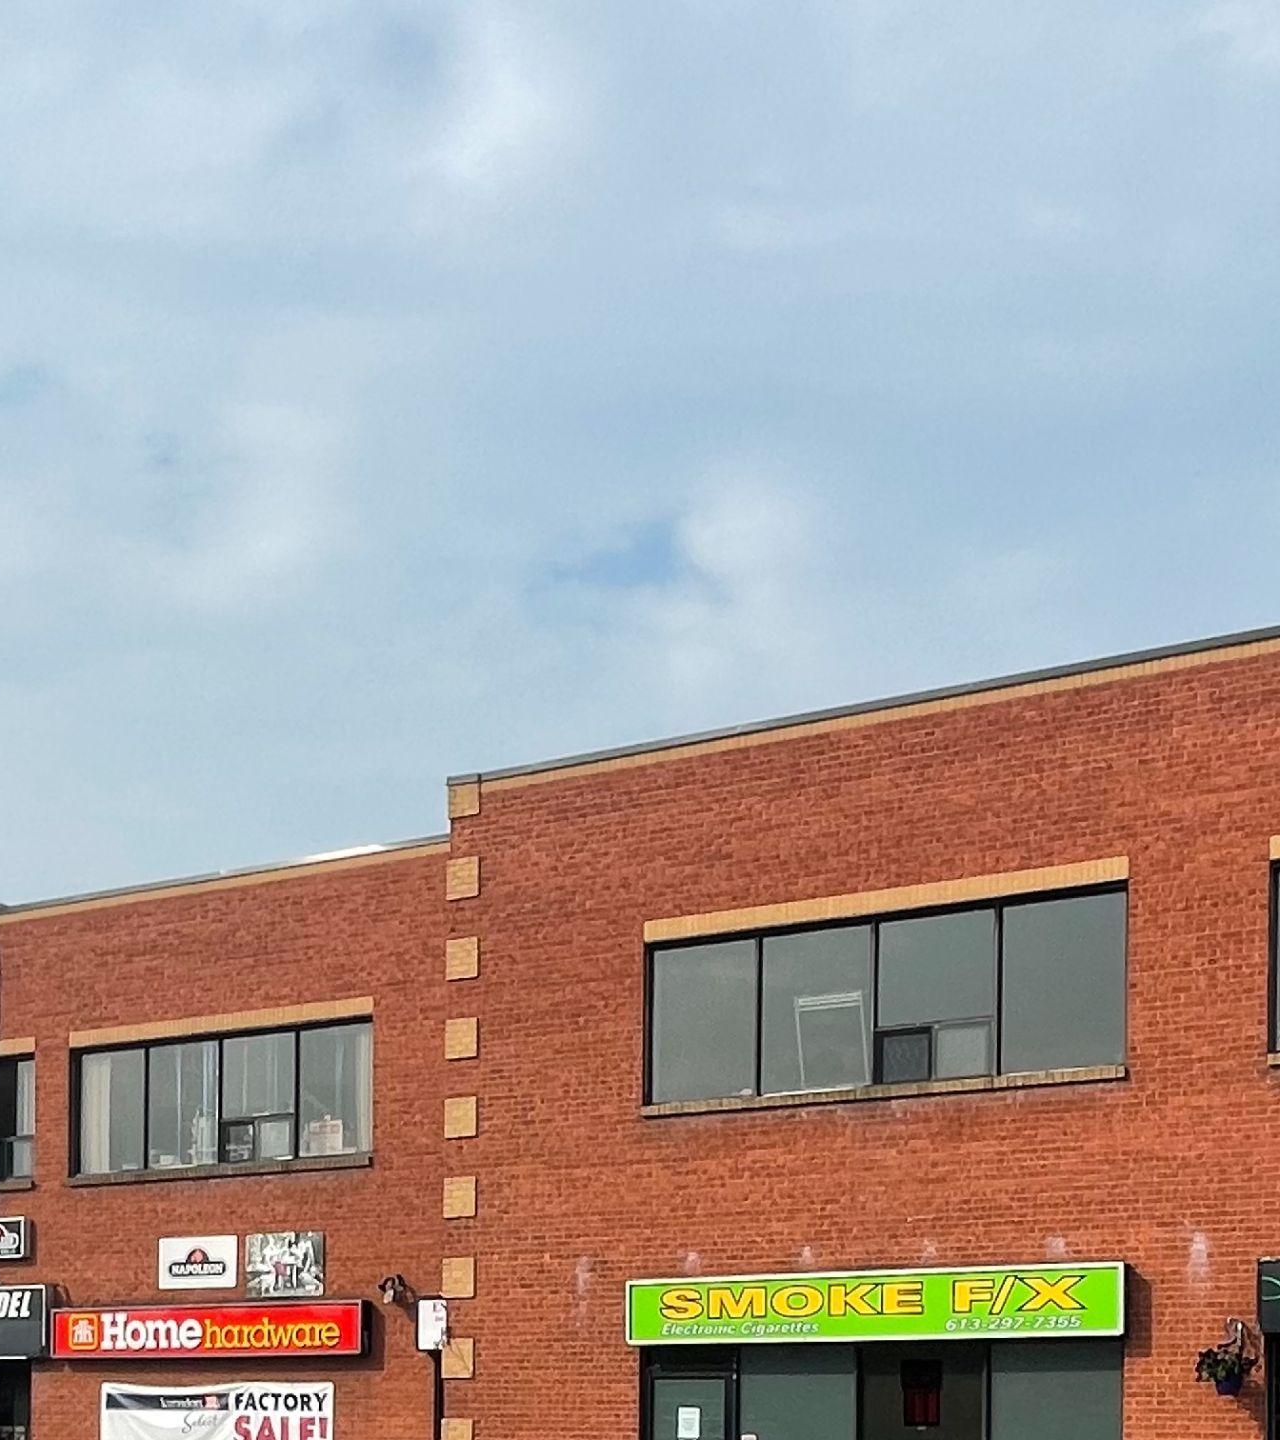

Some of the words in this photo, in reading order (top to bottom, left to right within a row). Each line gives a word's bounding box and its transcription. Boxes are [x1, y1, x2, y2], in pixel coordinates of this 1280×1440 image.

[659, 1281, 924, 1320] SMOKE
[952, 1275, 1087, 1315] F/X
[100, 1312, 203, 1350] Home
[204, 1316, 341, 1349] hardware
[741, 1321, 820, 1337] Cigarettes
[945, 1315, 1082, 1331] 613-297-7355
[234, 1392, 328, 1412] FACTORY
